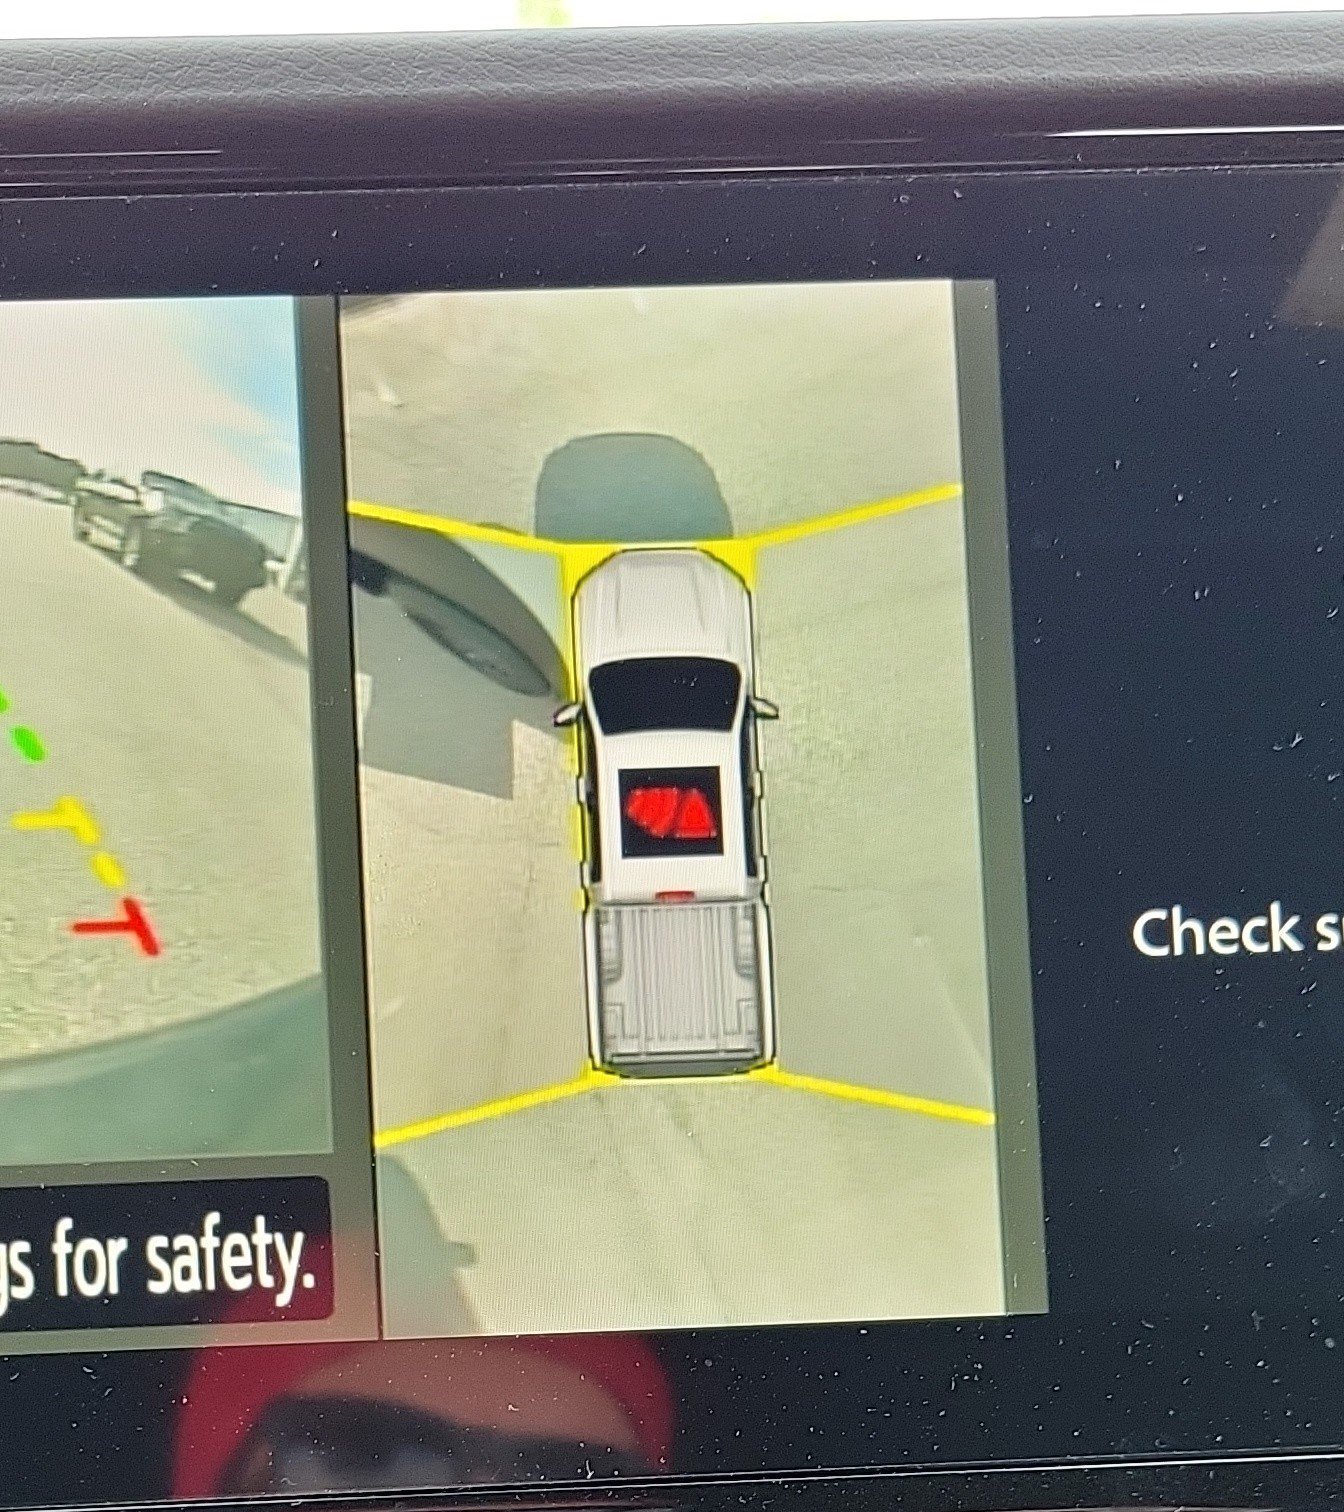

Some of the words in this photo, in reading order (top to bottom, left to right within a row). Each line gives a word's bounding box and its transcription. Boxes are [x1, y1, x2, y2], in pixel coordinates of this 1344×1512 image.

[1131, 901, 1301, 958] Check
[50, 1217, 128, 1298] for
[145, 1213, 317, 1308] safety.
